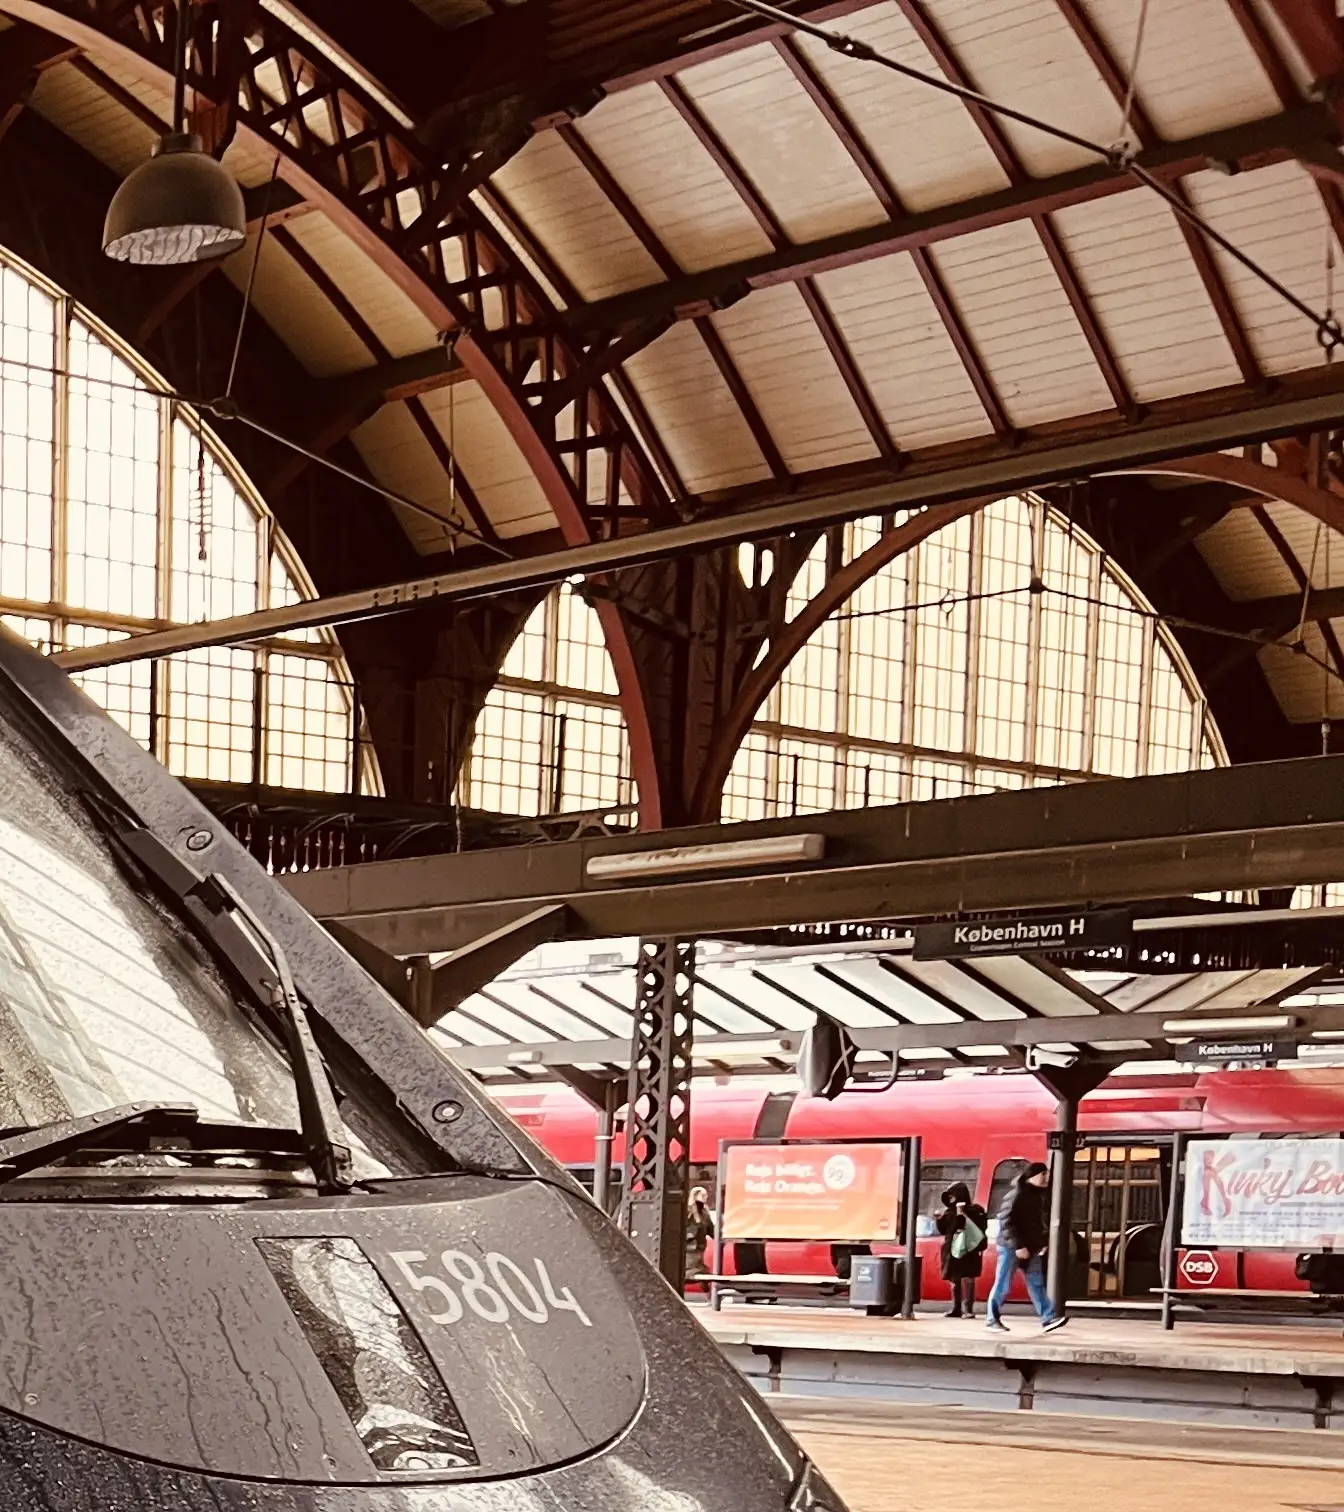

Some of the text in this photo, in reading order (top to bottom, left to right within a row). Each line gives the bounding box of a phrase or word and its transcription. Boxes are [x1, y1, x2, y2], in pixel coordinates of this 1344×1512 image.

[954, 918, 1085, 943] København H
[1263, 1042, 1273, 1052] H
[1200, 1150, 1294, 1217] Kinky
[1185, 1261, 1213, 1274] DSB
[388, 1250, 593, 1327] 5804
